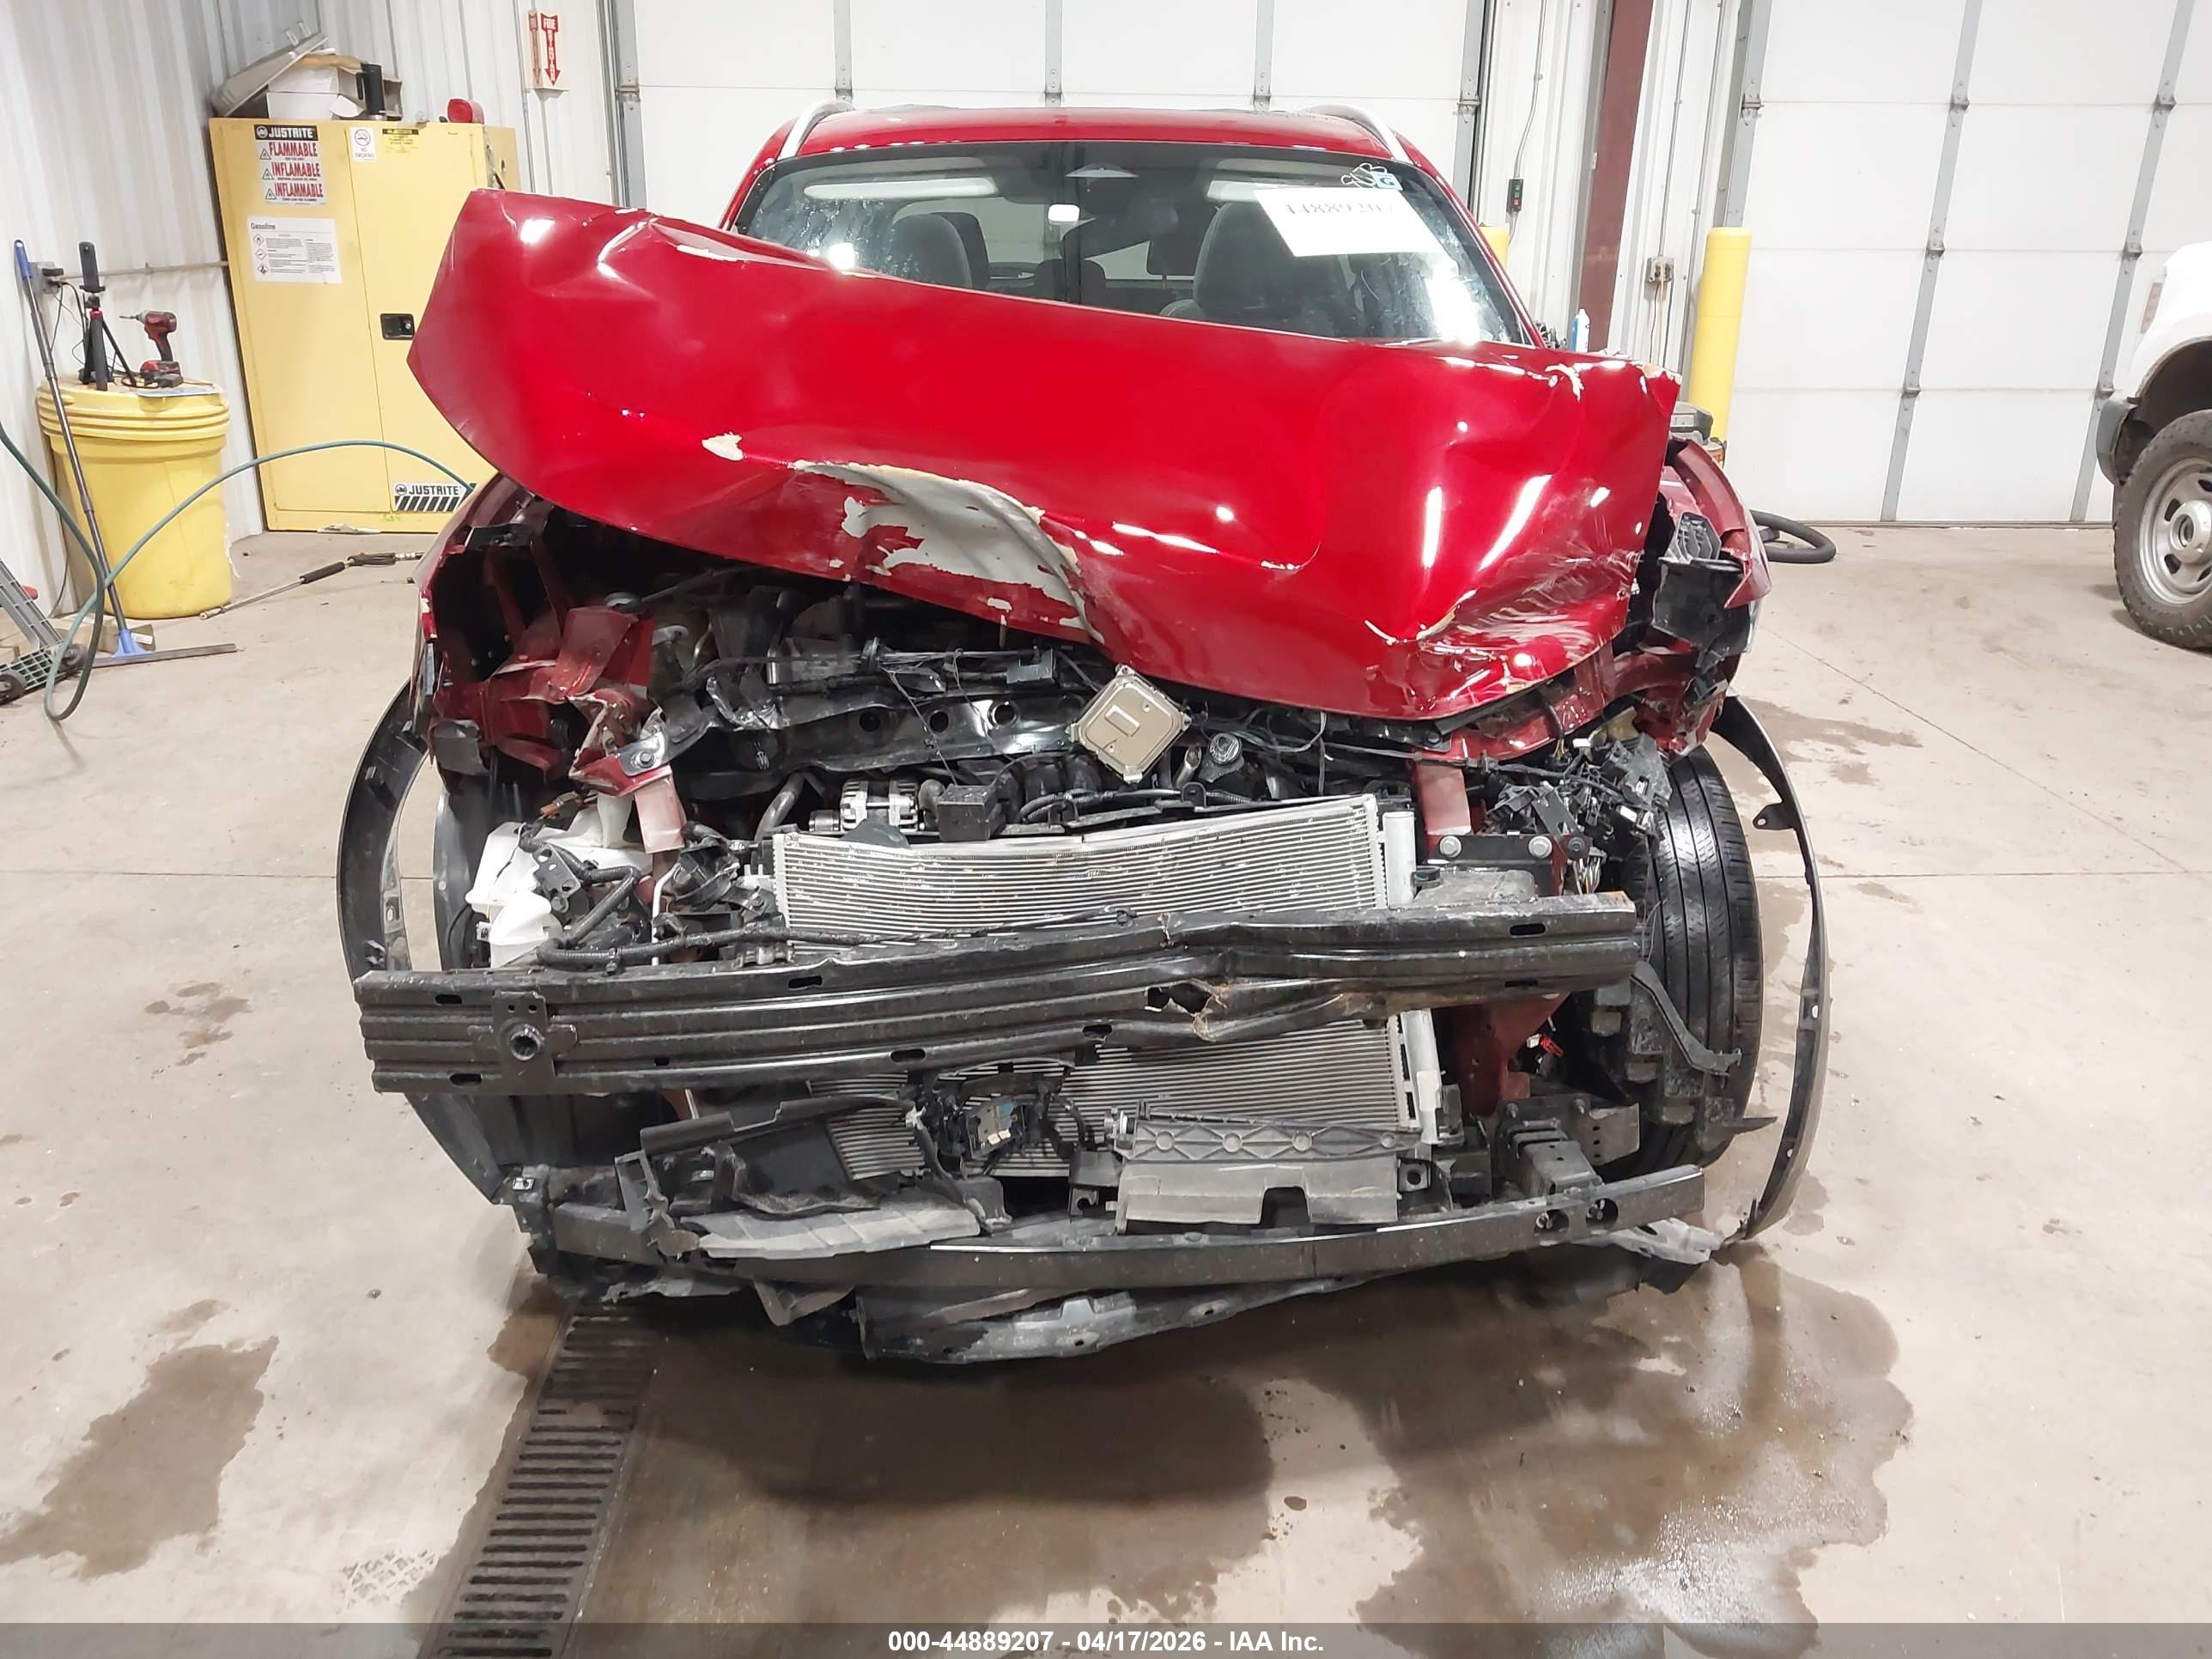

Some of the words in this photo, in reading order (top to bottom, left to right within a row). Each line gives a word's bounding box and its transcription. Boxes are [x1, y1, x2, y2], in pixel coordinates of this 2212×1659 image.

[269, 127, 313, 138] JUSTRITE
[269, 142, 318, 157] FLAMMABLE
[271, 161, 321, 177] INFLAMABLE
[275, 182, 324, 198] INFLAMMABLE
[409, 485, 459, 495] JUSTRITE
